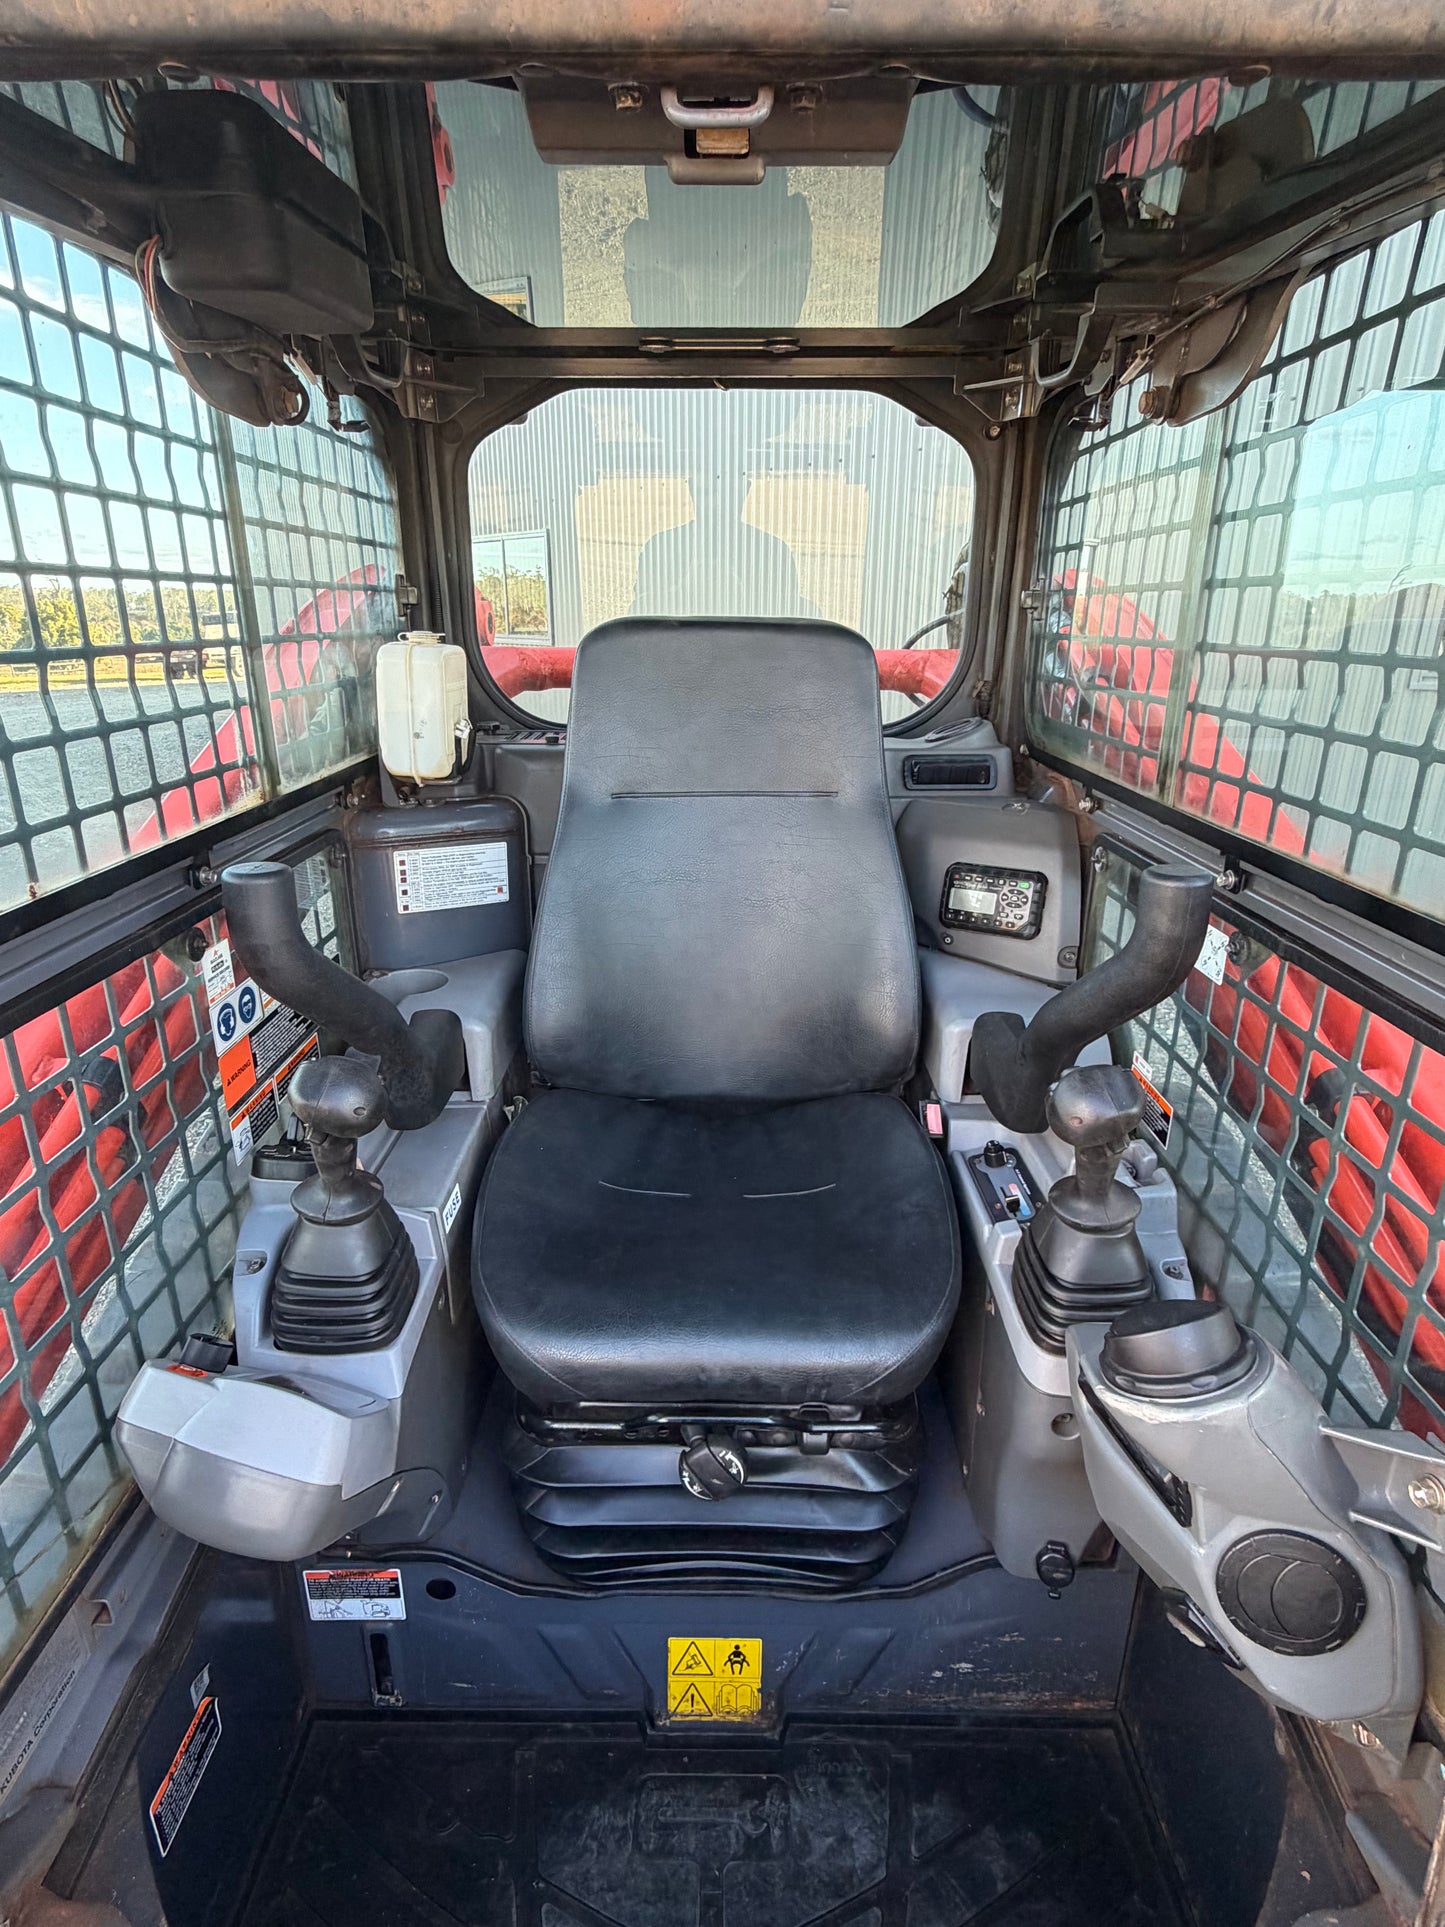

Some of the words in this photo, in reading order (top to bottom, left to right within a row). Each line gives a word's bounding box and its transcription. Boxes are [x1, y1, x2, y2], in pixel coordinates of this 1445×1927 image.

[231, 1059, 252, 1082] WARNING
[445, 1191, 460, 1226] FUSE
[0, 1739, 34, 1794] KUBOTA
[33, 1669, 76, 1736] Corporation
[173, 1711, 201, 1768] WARNING
